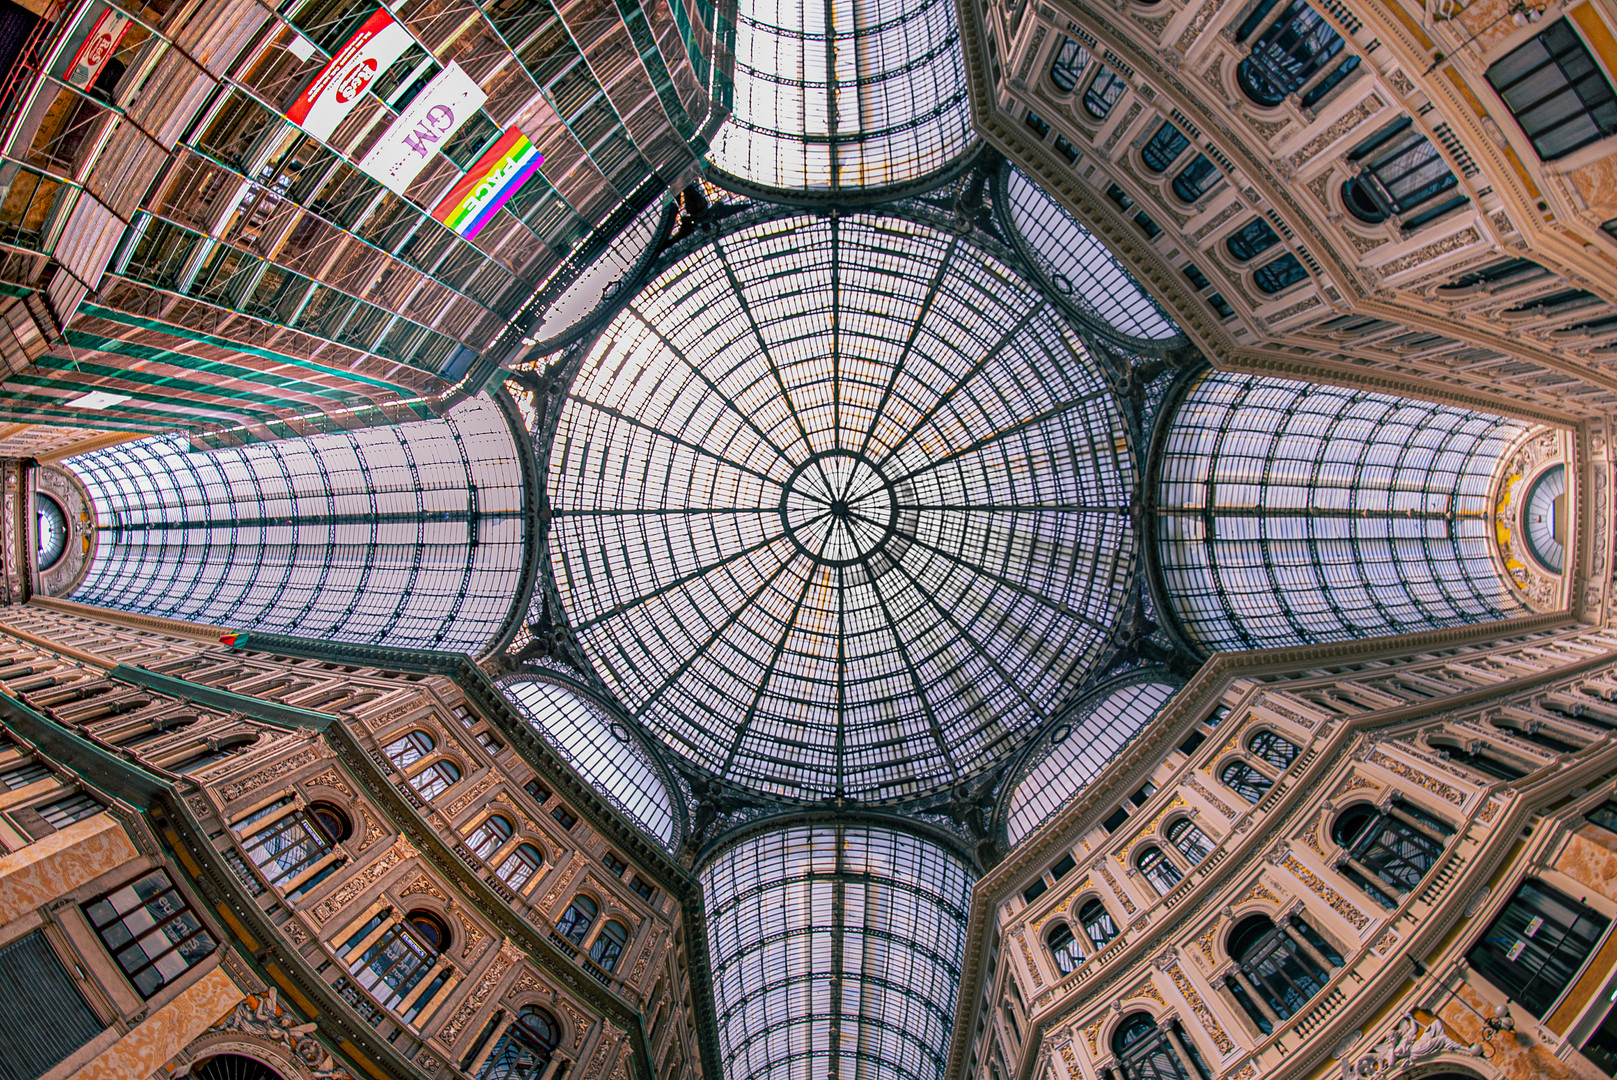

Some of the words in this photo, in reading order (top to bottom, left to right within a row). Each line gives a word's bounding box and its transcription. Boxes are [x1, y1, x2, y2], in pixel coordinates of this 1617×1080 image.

[342, 64, 374, 99] R&S
[401, 104, 454, 159] GM
[463, 156, 515, 211] PACE
[302, 822, 325, 846] EURONICS
[402, 934, 425, 959] EURONICS
